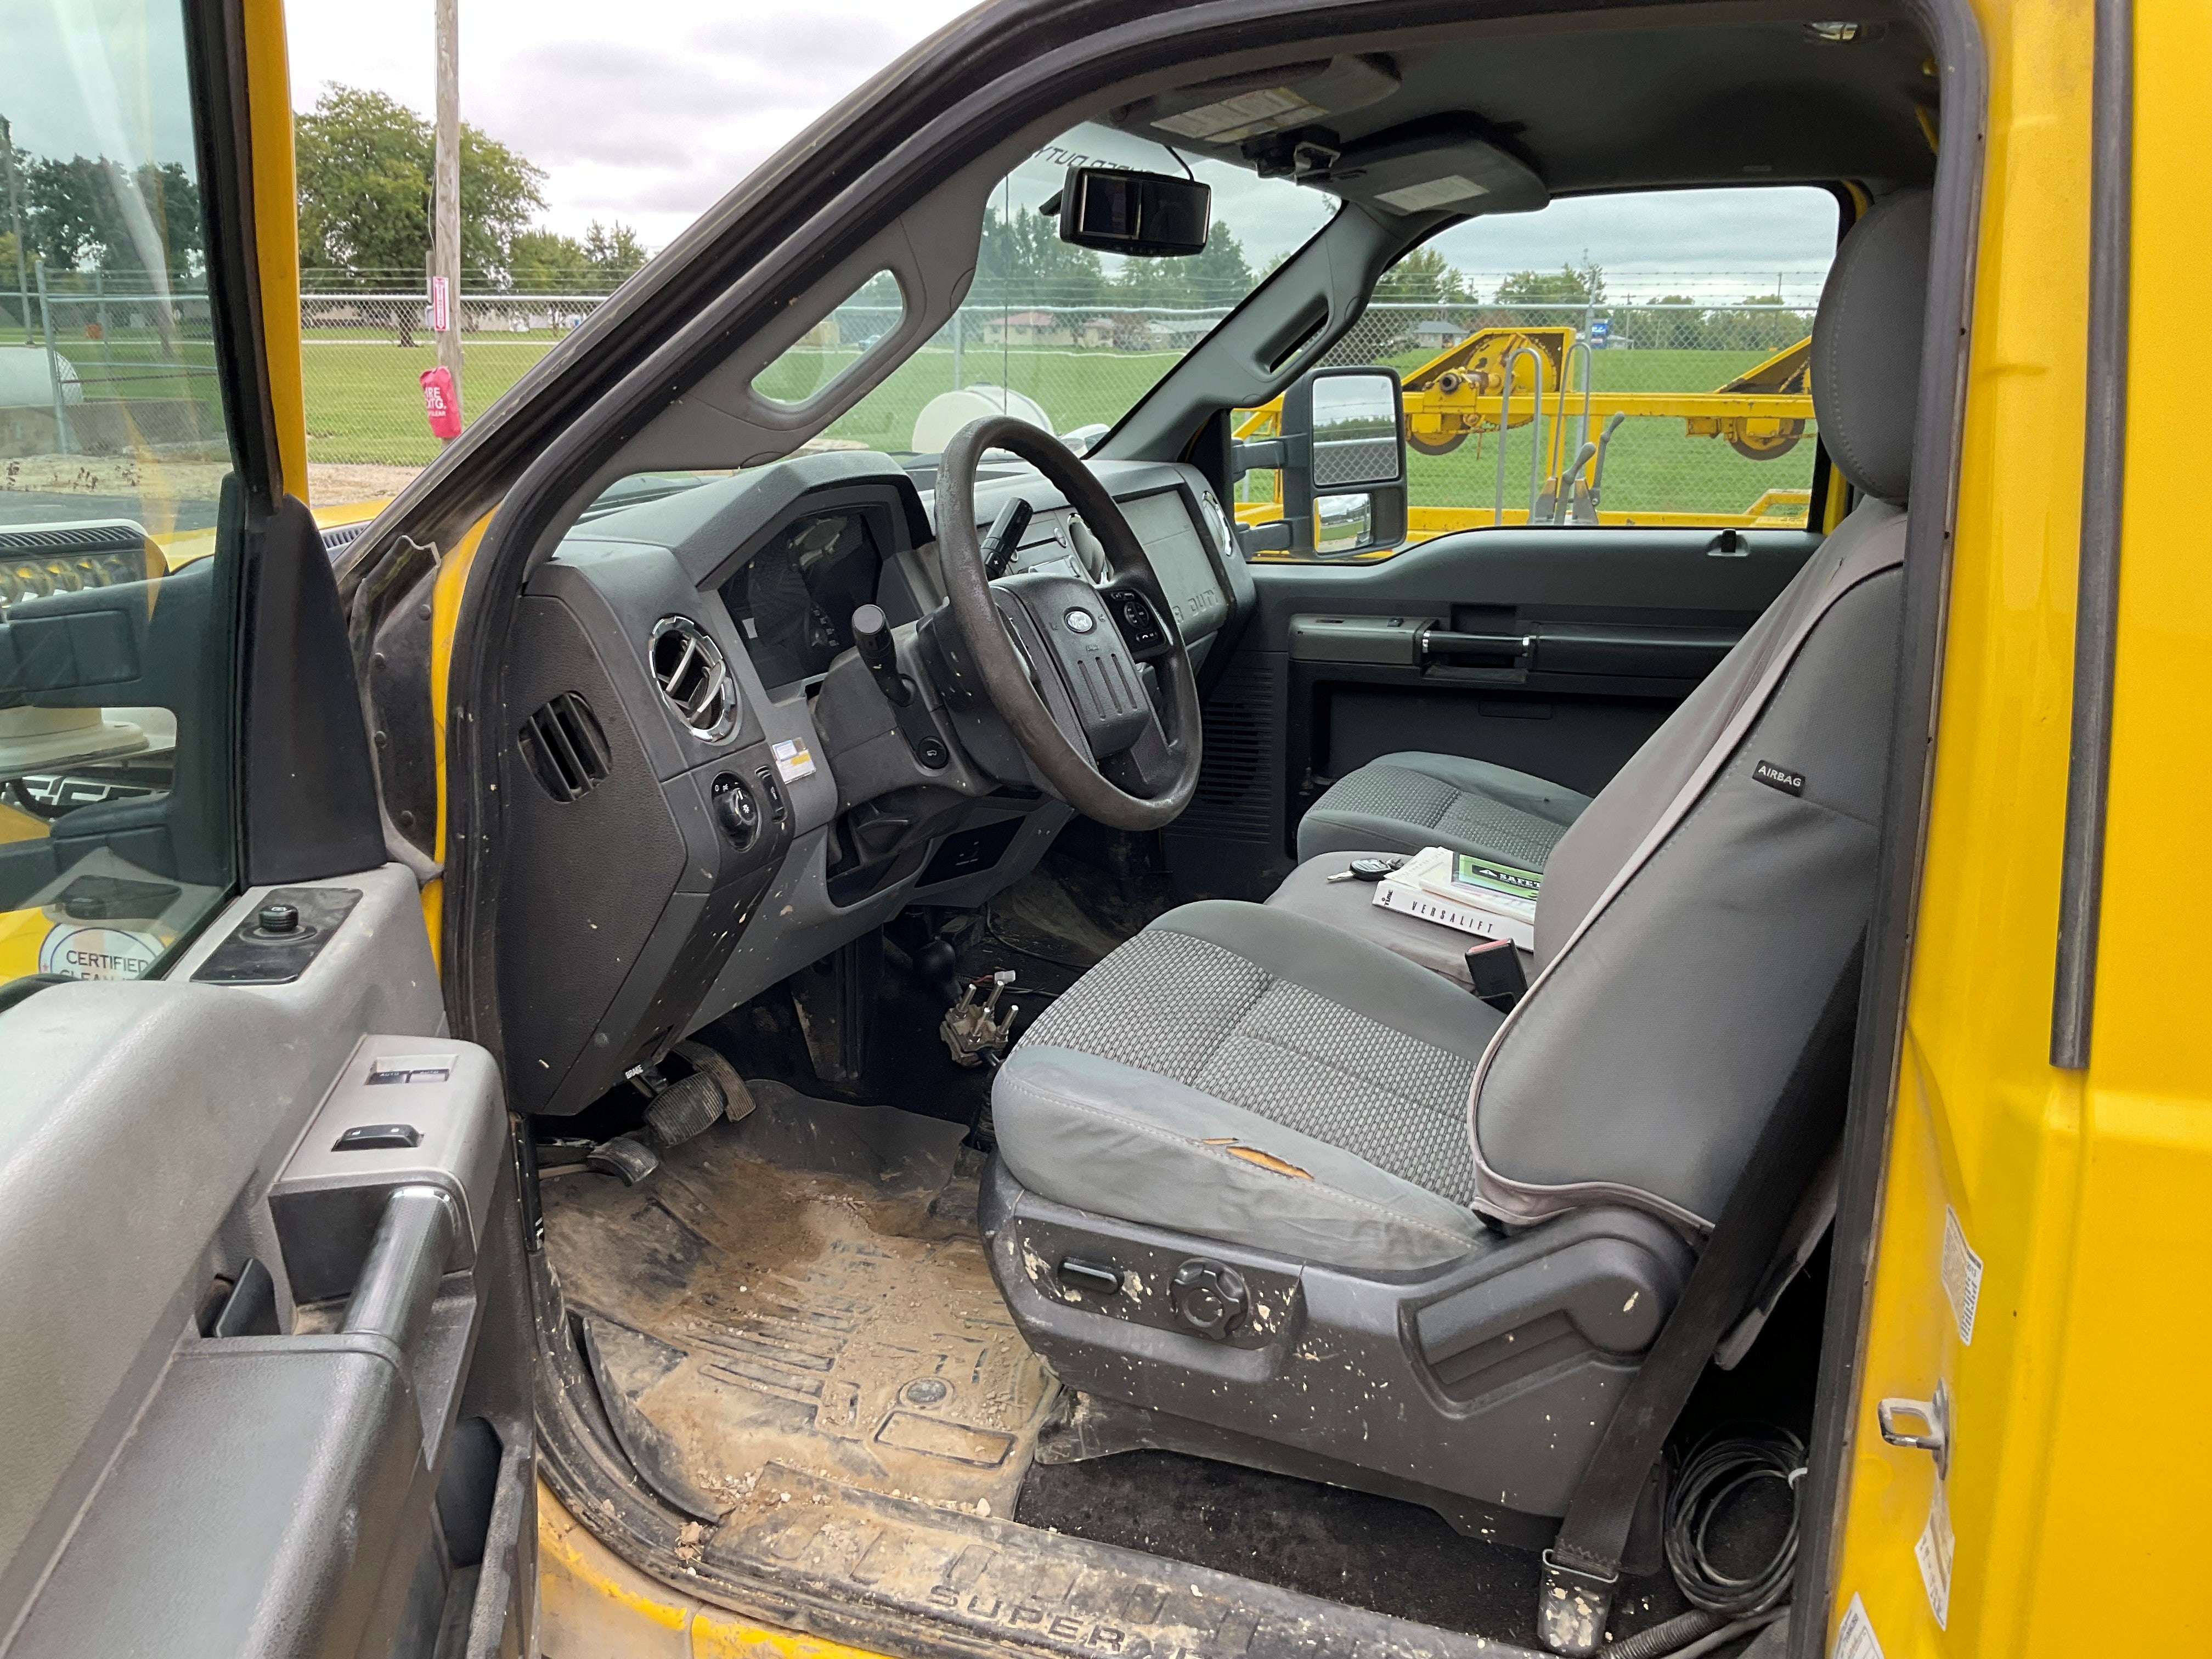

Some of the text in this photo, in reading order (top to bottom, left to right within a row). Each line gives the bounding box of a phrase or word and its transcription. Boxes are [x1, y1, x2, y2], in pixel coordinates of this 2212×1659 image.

[425, 387, 441, 399] IRE
[1188, 588, 1218, 614] DUTY
[1068, 613, 1090, 629] Ford
[1758, 765, 1802, 787] AIRBAG
[1499, 873, 1540, 888] SAFET
[1412, 901, 1493, 933] VERSALIFT
[66, 950, 148, 973] CERTIFIED
[929, 1584, 1125, 1652] SUPER
